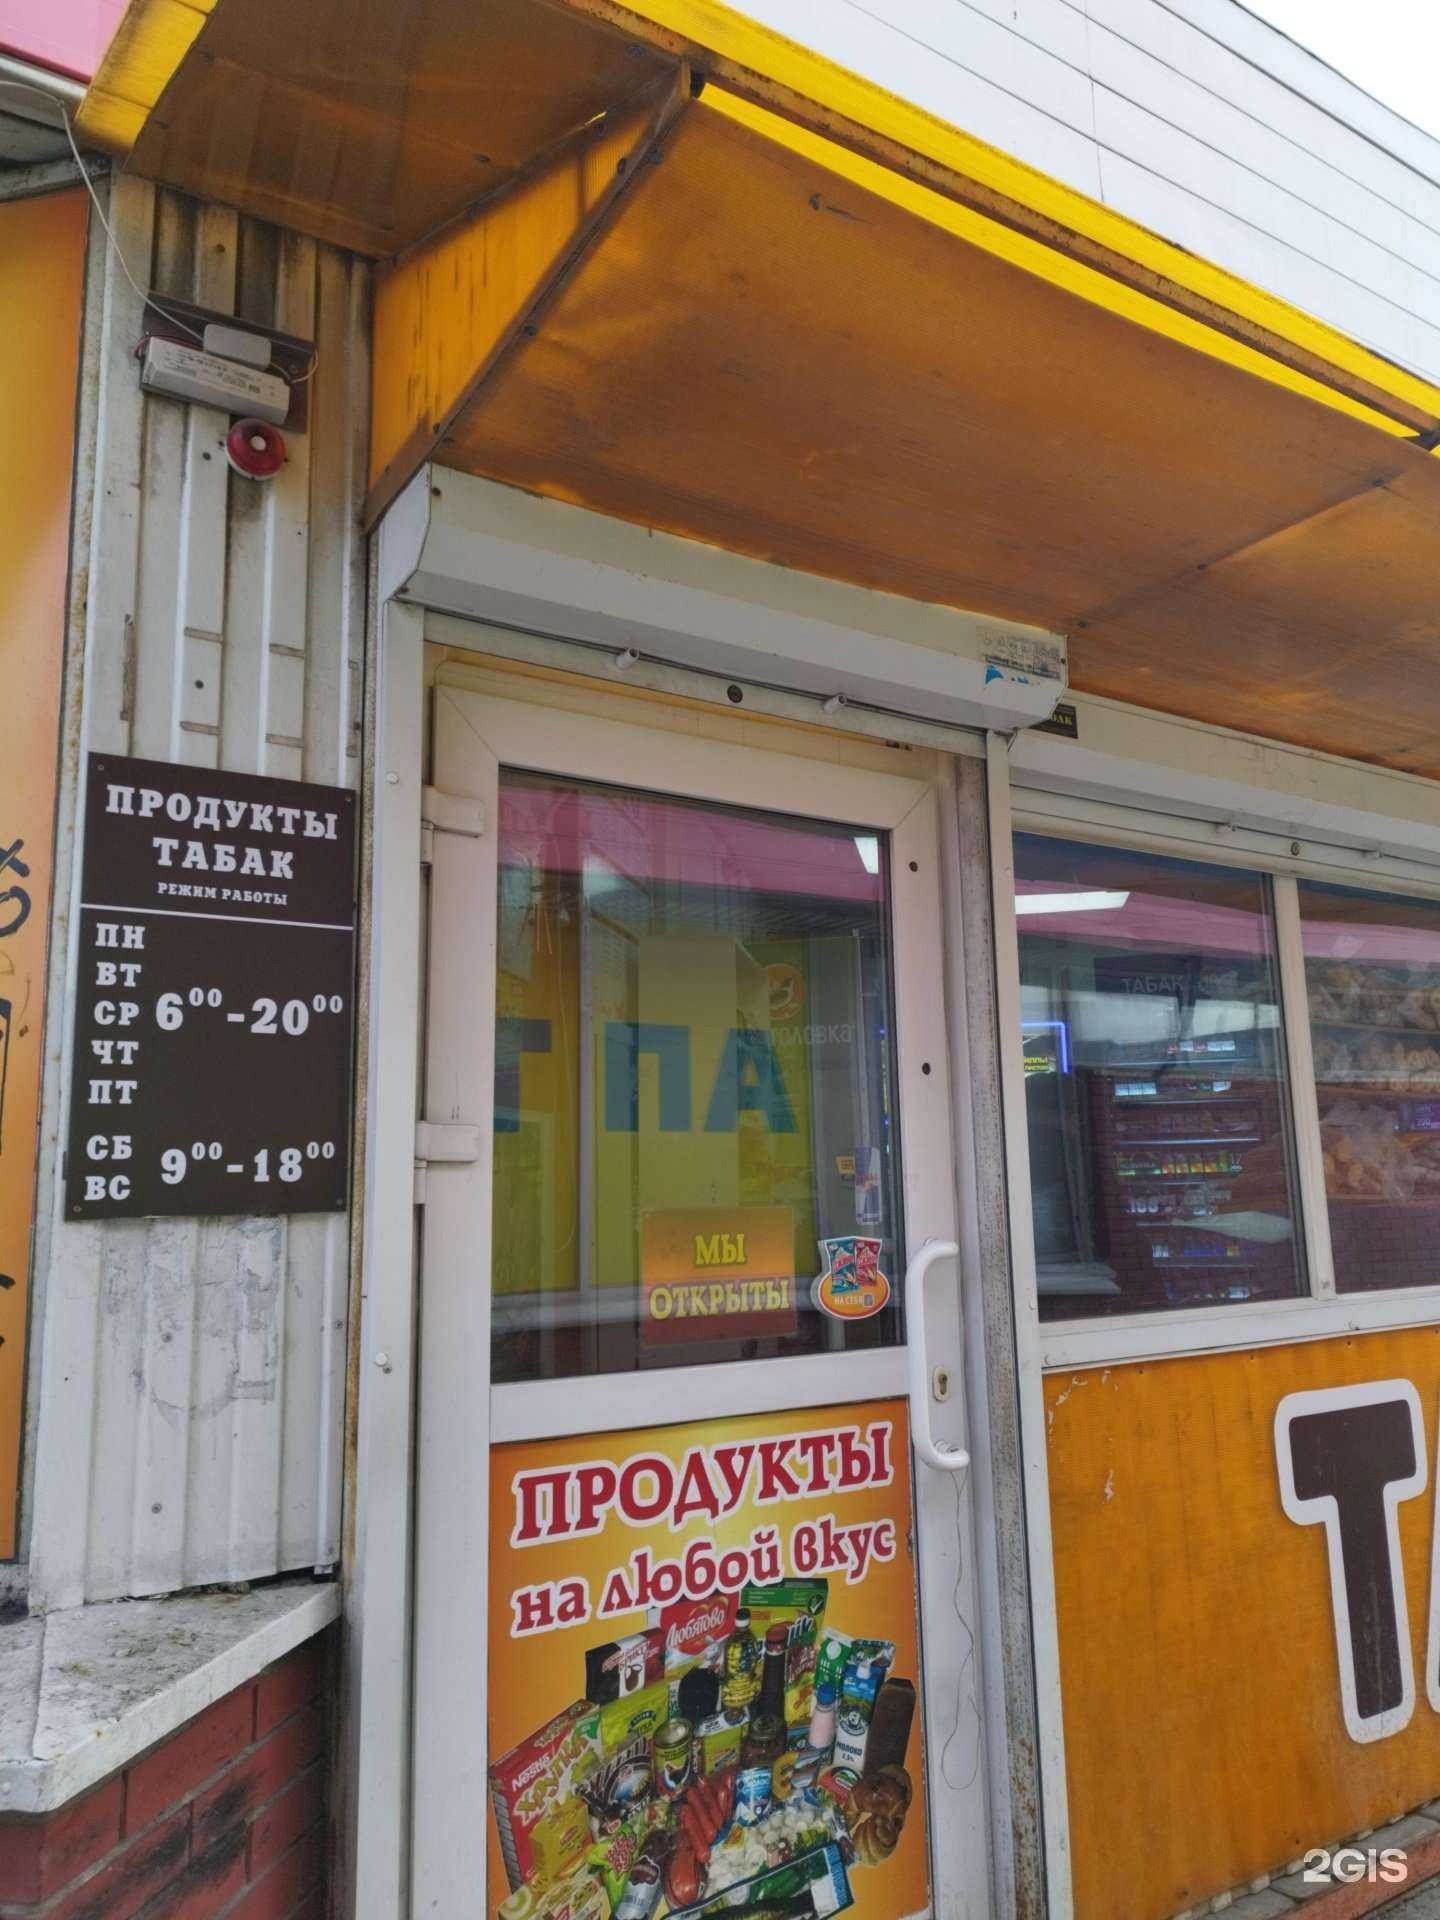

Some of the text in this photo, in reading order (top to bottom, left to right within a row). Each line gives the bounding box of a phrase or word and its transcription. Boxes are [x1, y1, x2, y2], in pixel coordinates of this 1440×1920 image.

[106, 784, 338, 840] ПРОДУКТЫ
[152, 837, 294, 880] ТАБАК
[157, 882, 288, 906] РЕЖИМ РАБОТЫ
[95, 923, 146, 950] ПН
[95, 961, 142, 987] ВТ
[1120, 975, 1184, 994] ТАБАК
[94, 1001, 141, 1027] СР
[91, 1040, 139, 1066] ЧТ
[87, 1079, 138, 1104] ПТ
[86, 1135, 133, 1161] СБ
[84, 1175, 132, 1202] ВС
[694, 1233, 746, 1265] МЫ
[650, 1279, 790, 1320] ОТКРЫТЫ
[513, 1424, 892, 1544] ПРОДУКТЫ
[1275, 1378, 1440, 1744] Т
[513, 1515, 894, 1636] на любой вкус
